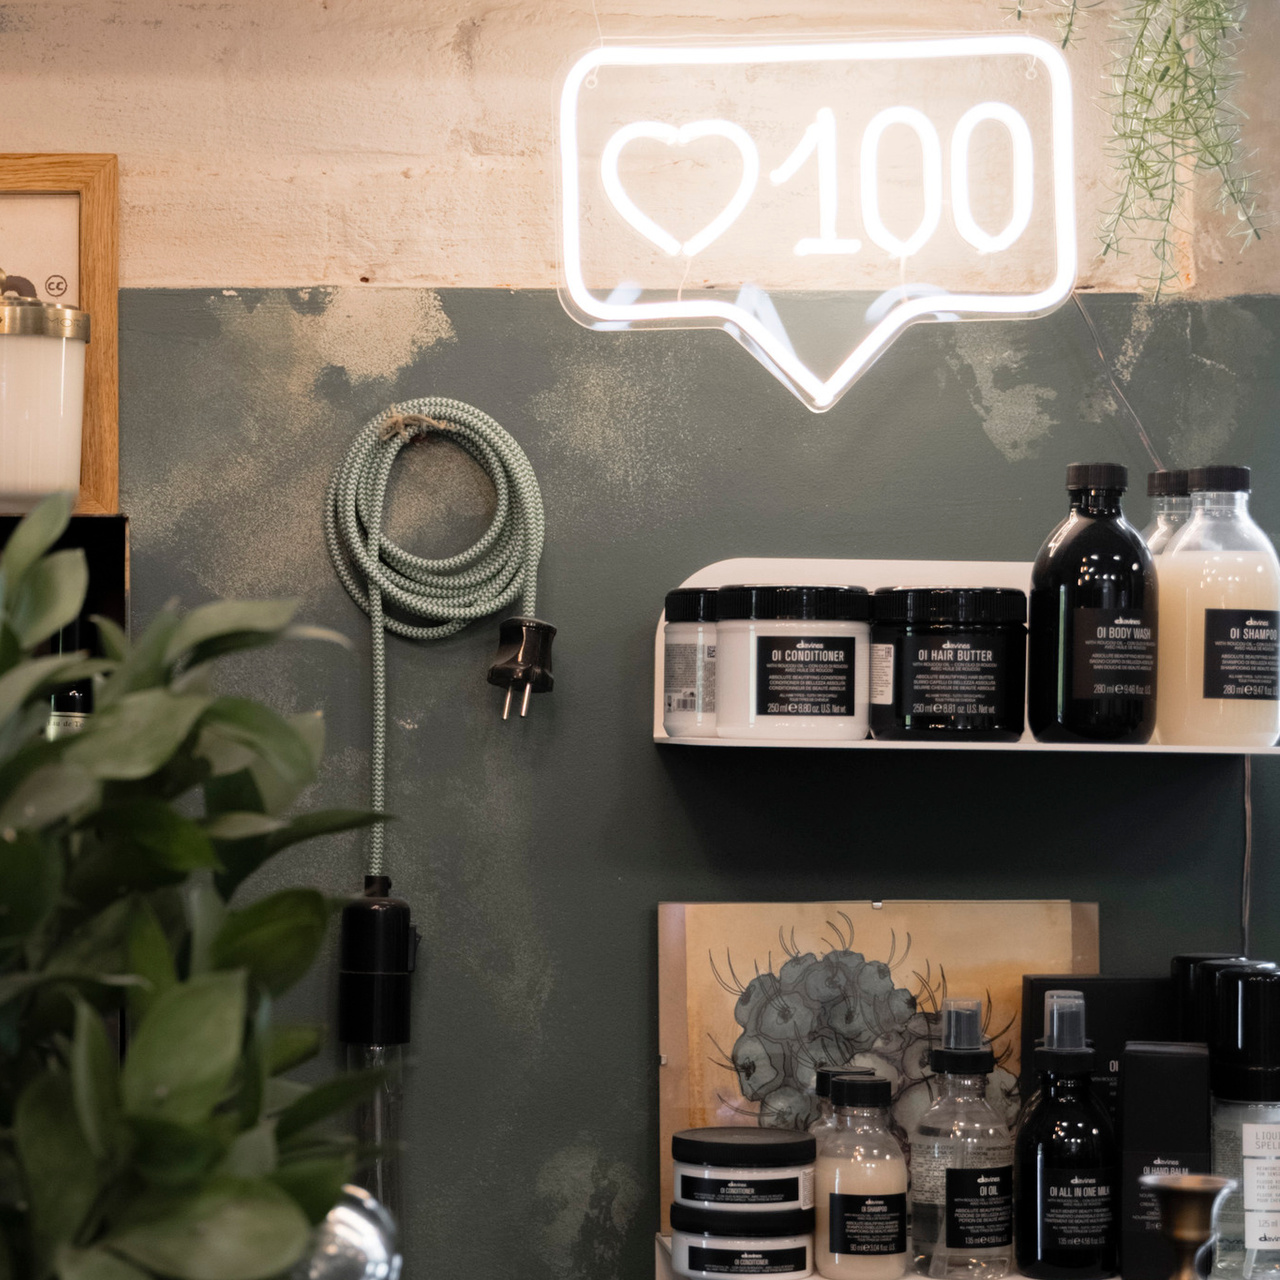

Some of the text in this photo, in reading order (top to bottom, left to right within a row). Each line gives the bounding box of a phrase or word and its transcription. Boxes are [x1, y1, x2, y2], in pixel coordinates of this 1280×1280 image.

[770, 101, 1033, 257] 100
[1097, 627, 1151, 640] OI BODY WASH
[1230, 628, 1277, 640] OI SHAMPOO
[772, 650, 844, 662] OI CONDITIONER
[918, 650, 992, 661] OI HAIR BUTTER
[1151, 1167, 1169, 1175] HAND
[1170, 1167, 1189, 1175] BALM
[1059, 1187, 1072, 1197] ALL
[1083, 1187, 1096, 1196] ONE
